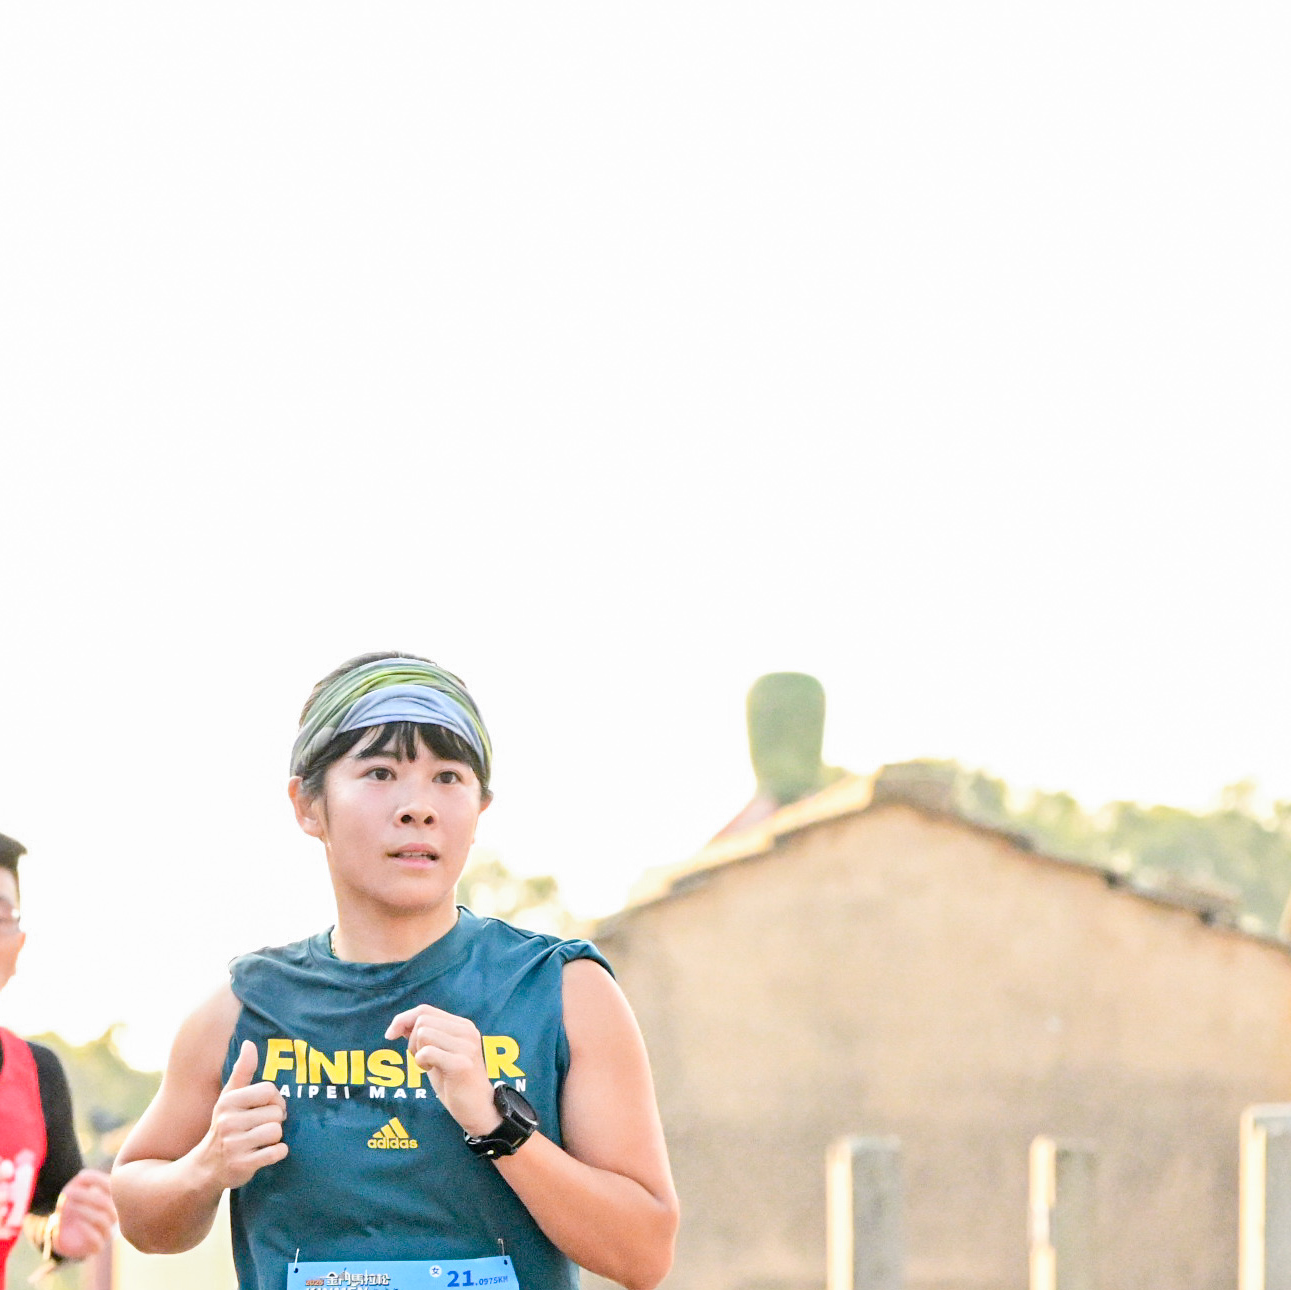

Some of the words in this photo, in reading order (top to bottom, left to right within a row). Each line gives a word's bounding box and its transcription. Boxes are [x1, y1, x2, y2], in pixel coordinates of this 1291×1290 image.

[262, 1035, 526, 1089] FINISR
[279, 1083, 351, 1100] AIPEI
[367, 1136, 419, 1150] adidas
